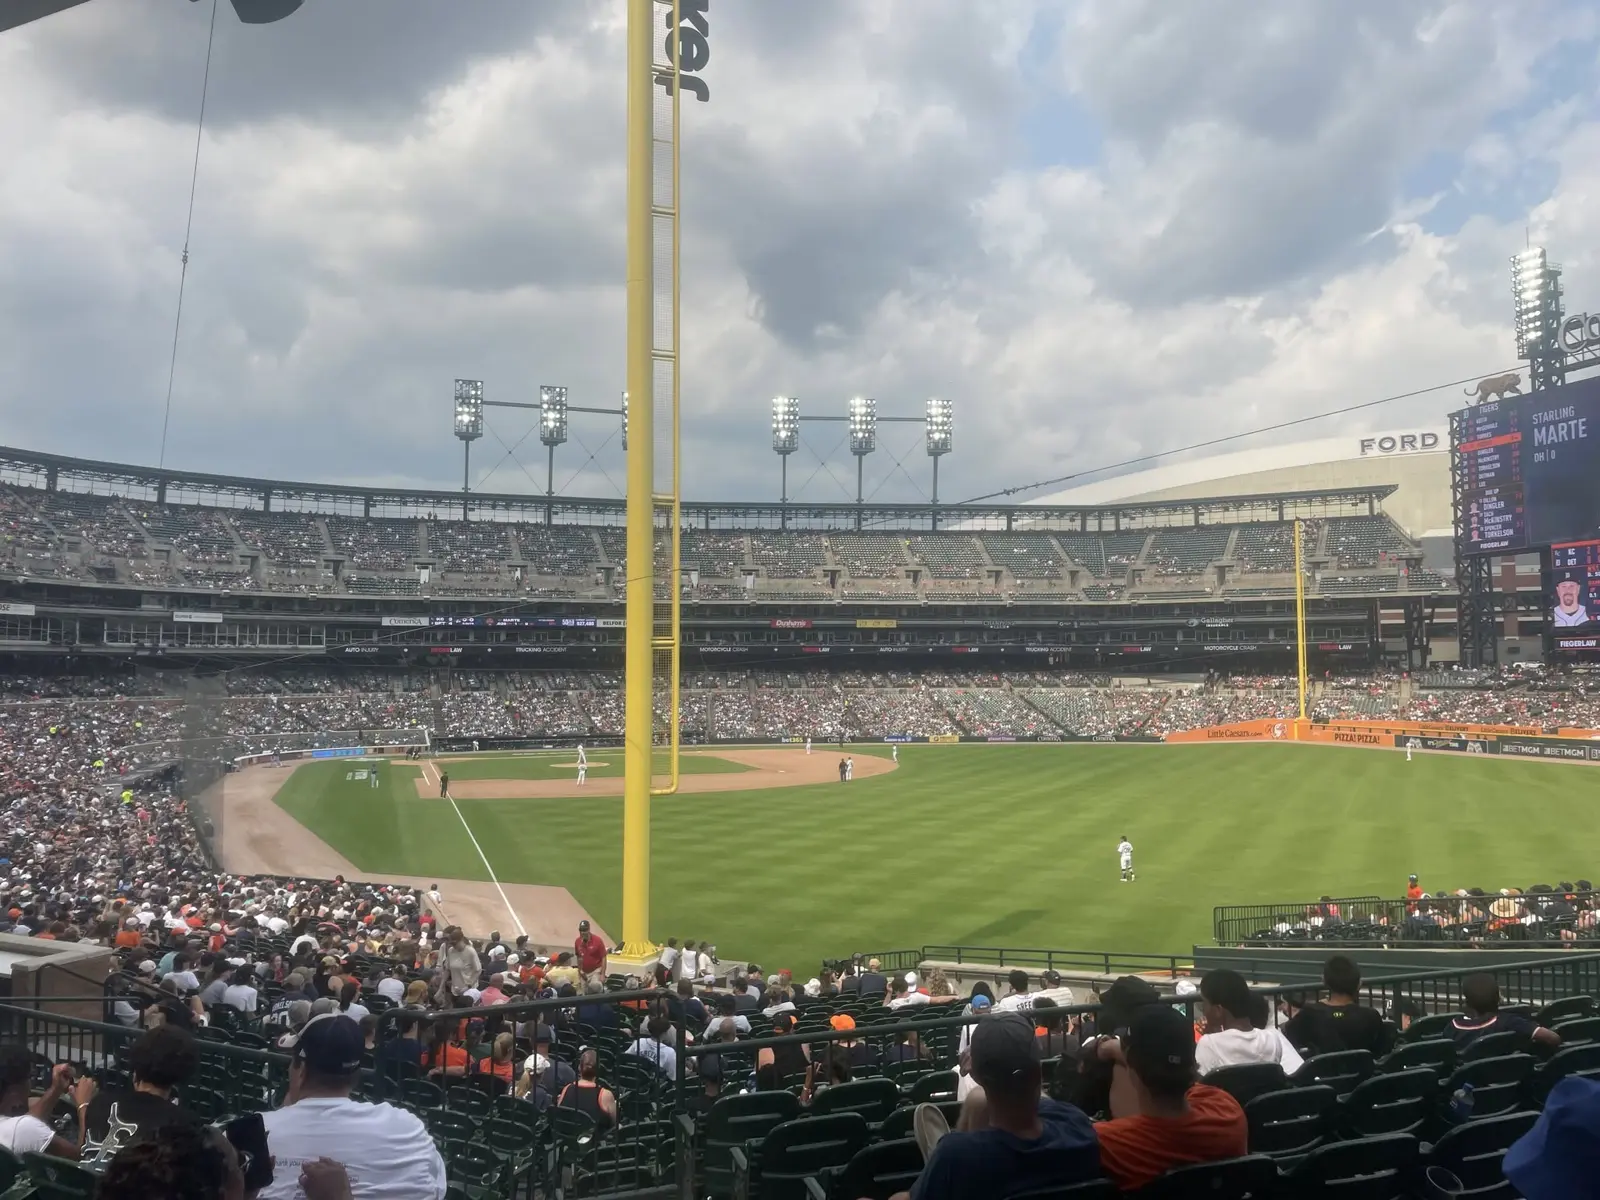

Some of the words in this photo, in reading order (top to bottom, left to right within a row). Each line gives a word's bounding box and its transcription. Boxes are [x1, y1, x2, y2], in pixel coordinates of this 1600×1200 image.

[1480, 403, 1499, 414] TIGERS
[1532, 406, 1575, 424] STARLING
[1534, 418, 1587, 446] MARTE
[1360, 433, 1439, 455] FORD
[1483, 501, 1505, 510] DINGLER
[1484, 514, 1513, 524] McKINSTRY
[1484, 528, 1514, 538] TORKELSON
[1207, 729, 1225, 738] Little
[1334, 732, 1357, 742] PIZZA!
[1357, 734, 1380, 744] PIZZA!
[1508, 745, 1540, 754] BETMGM
[1550, 747, 1584, 757] BETMGM
